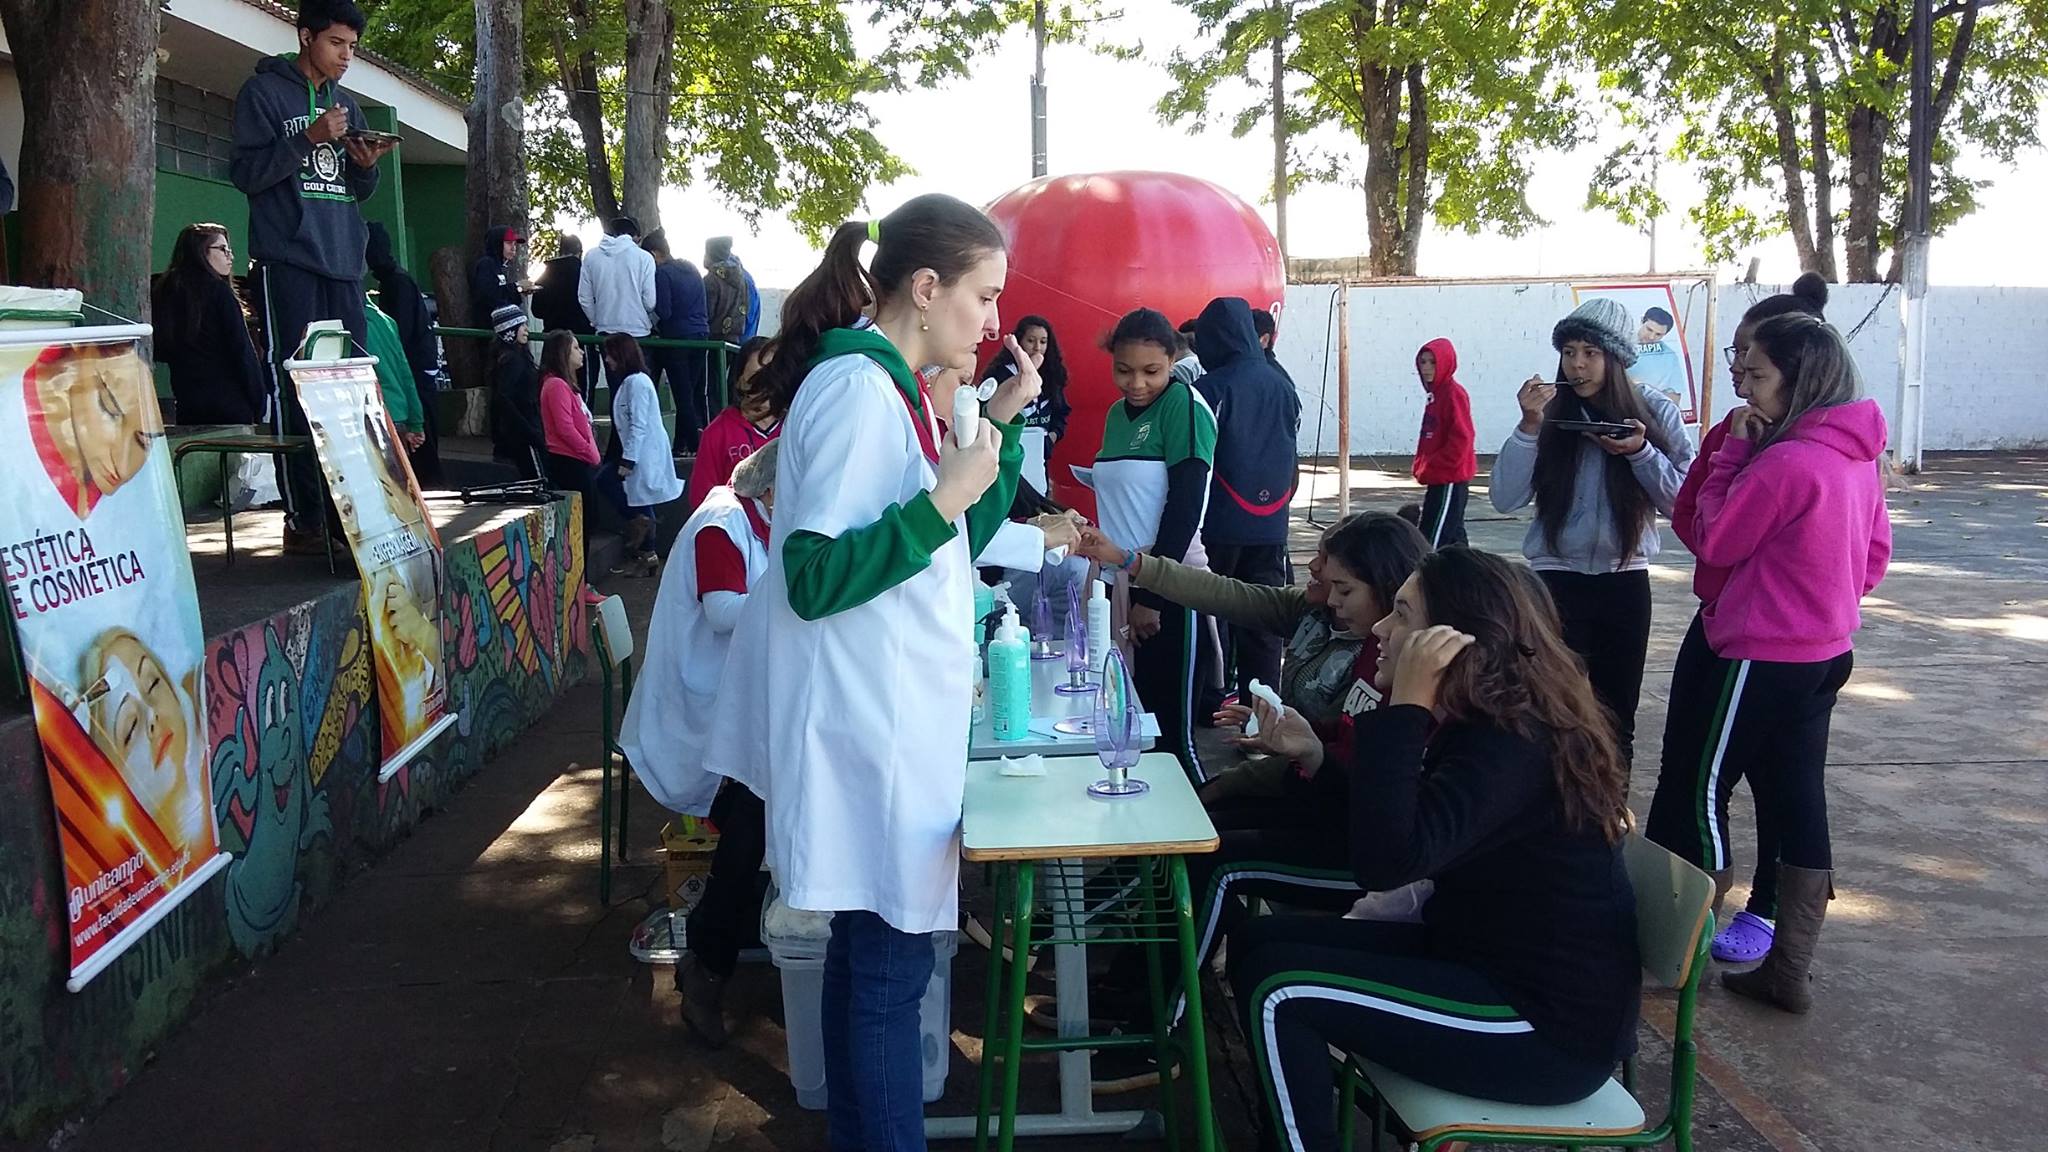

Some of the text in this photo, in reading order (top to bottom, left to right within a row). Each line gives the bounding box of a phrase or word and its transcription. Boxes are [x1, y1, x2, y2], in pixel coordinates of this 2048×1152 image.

[0, 527, 96, 583] ESTÉTICA
[9, 550, 146, 620] E COSMÉTICA
[83, 851, 145, 904] unicampo
